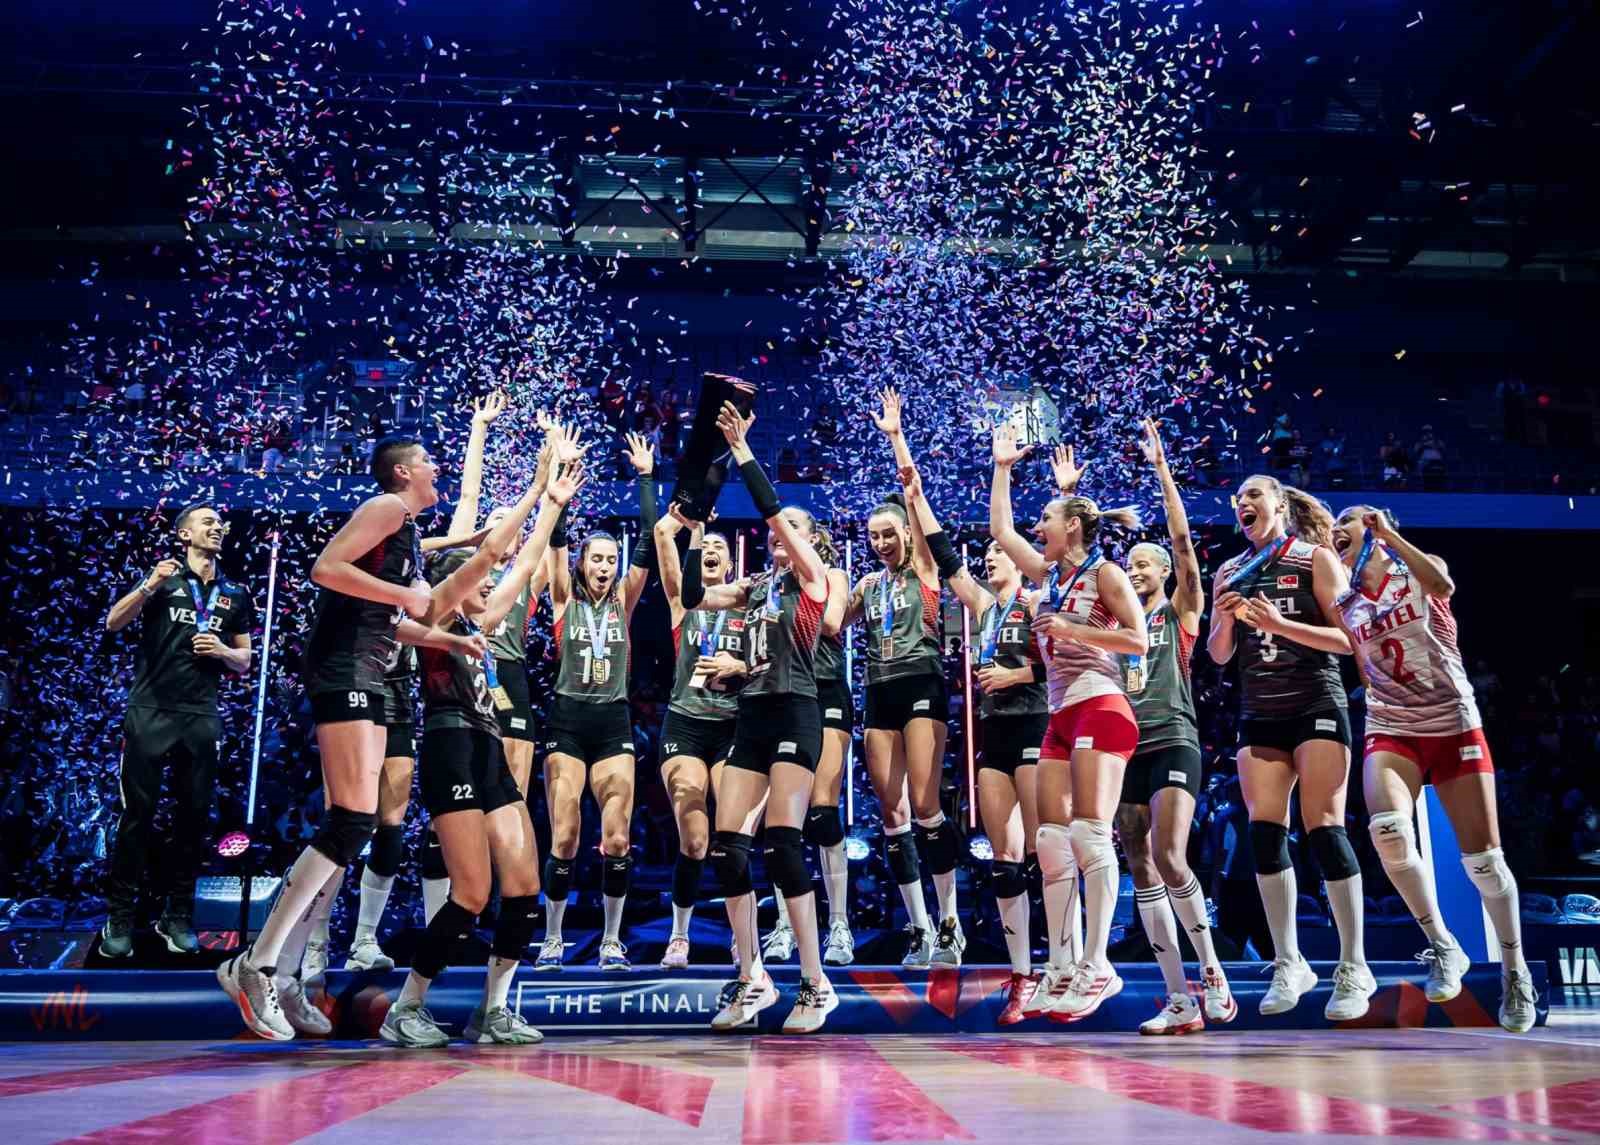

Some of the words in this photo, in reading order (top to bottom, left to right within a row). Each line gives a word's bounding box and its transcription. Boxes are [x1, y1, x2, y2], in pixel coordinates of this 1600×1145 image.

[1255, 627, 1278, 662] 3
[1381, 639, 1416, 684] 2
[348, 691, 369, 708] 99
[663, 743, 679, 754] 12
[451, 784, 474, 800] 22
[545, 994, 601, 1014] THE
